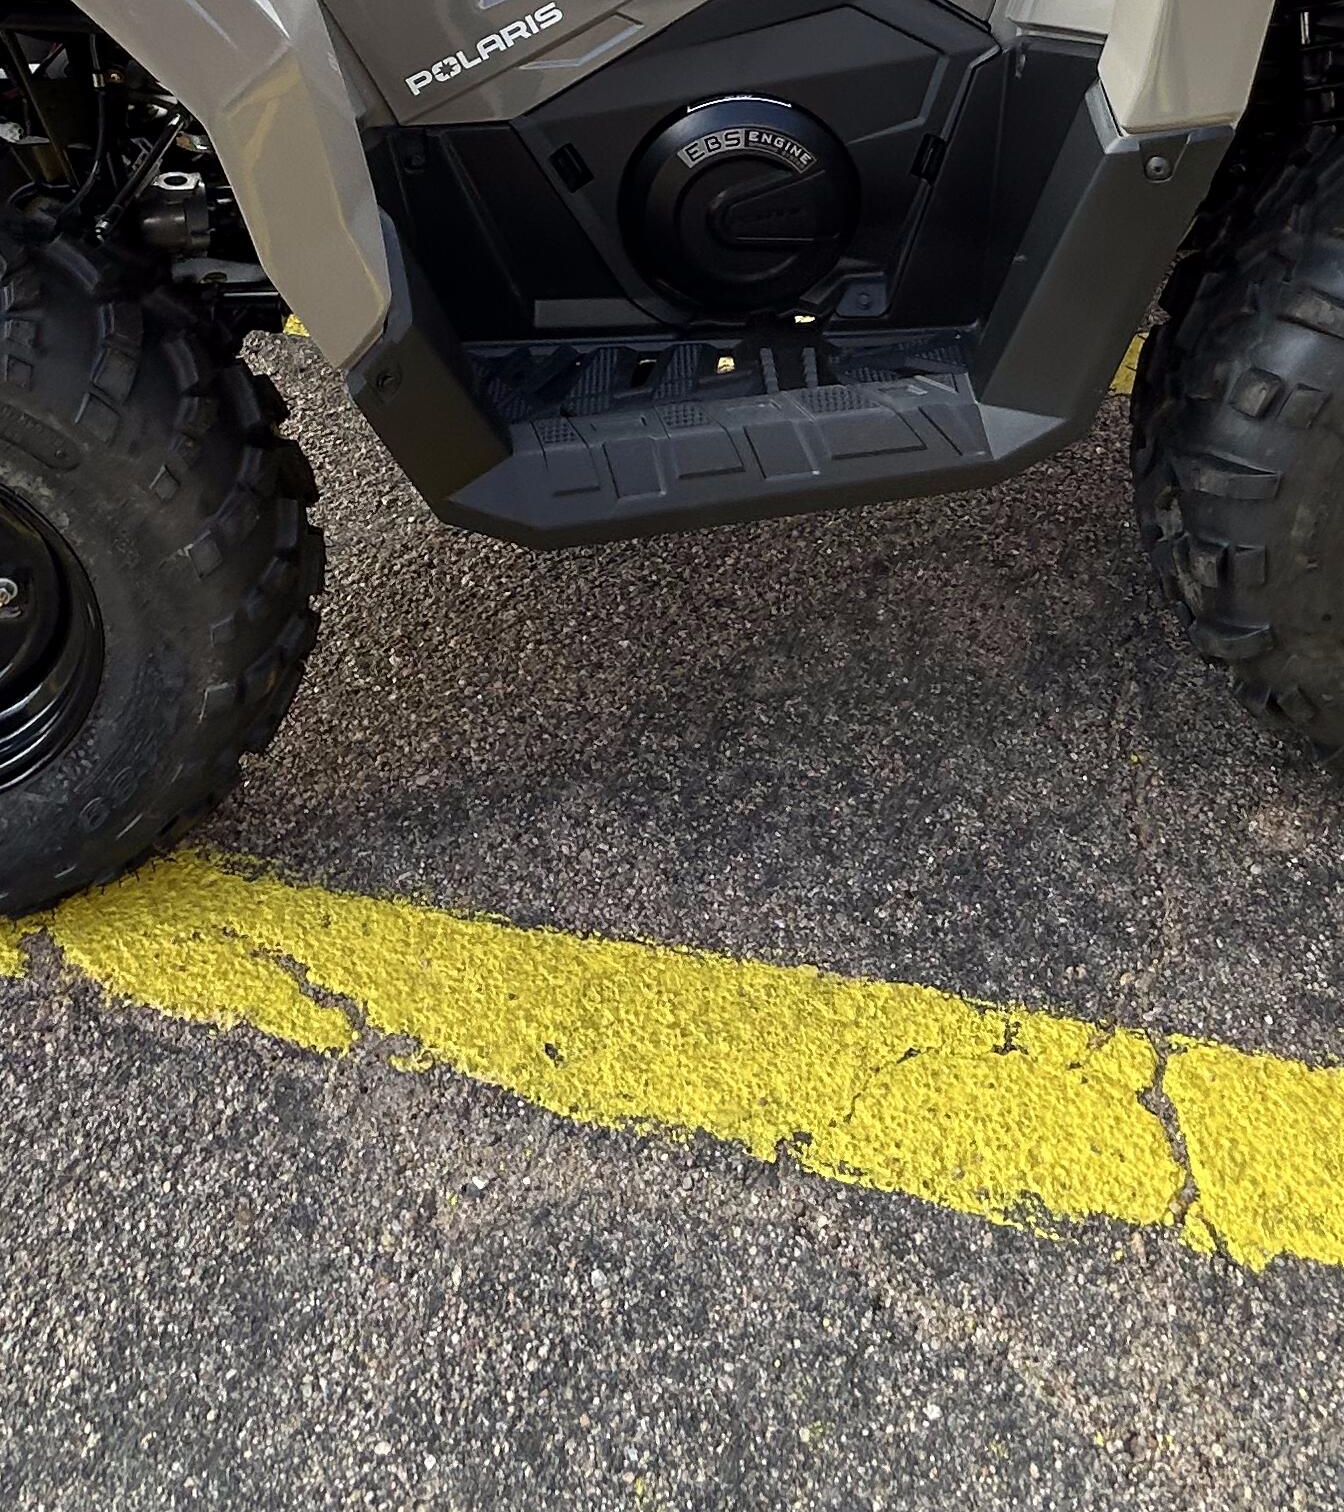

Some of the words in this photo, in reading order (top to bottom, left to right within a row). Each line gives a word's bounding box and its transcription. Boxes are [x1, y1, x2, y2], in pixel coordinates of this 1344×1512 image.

[405, 1, 564, 97] POLARIS
[683, 129, 742, 163] EBS
[748, 130, 813, 166] ENGINE
